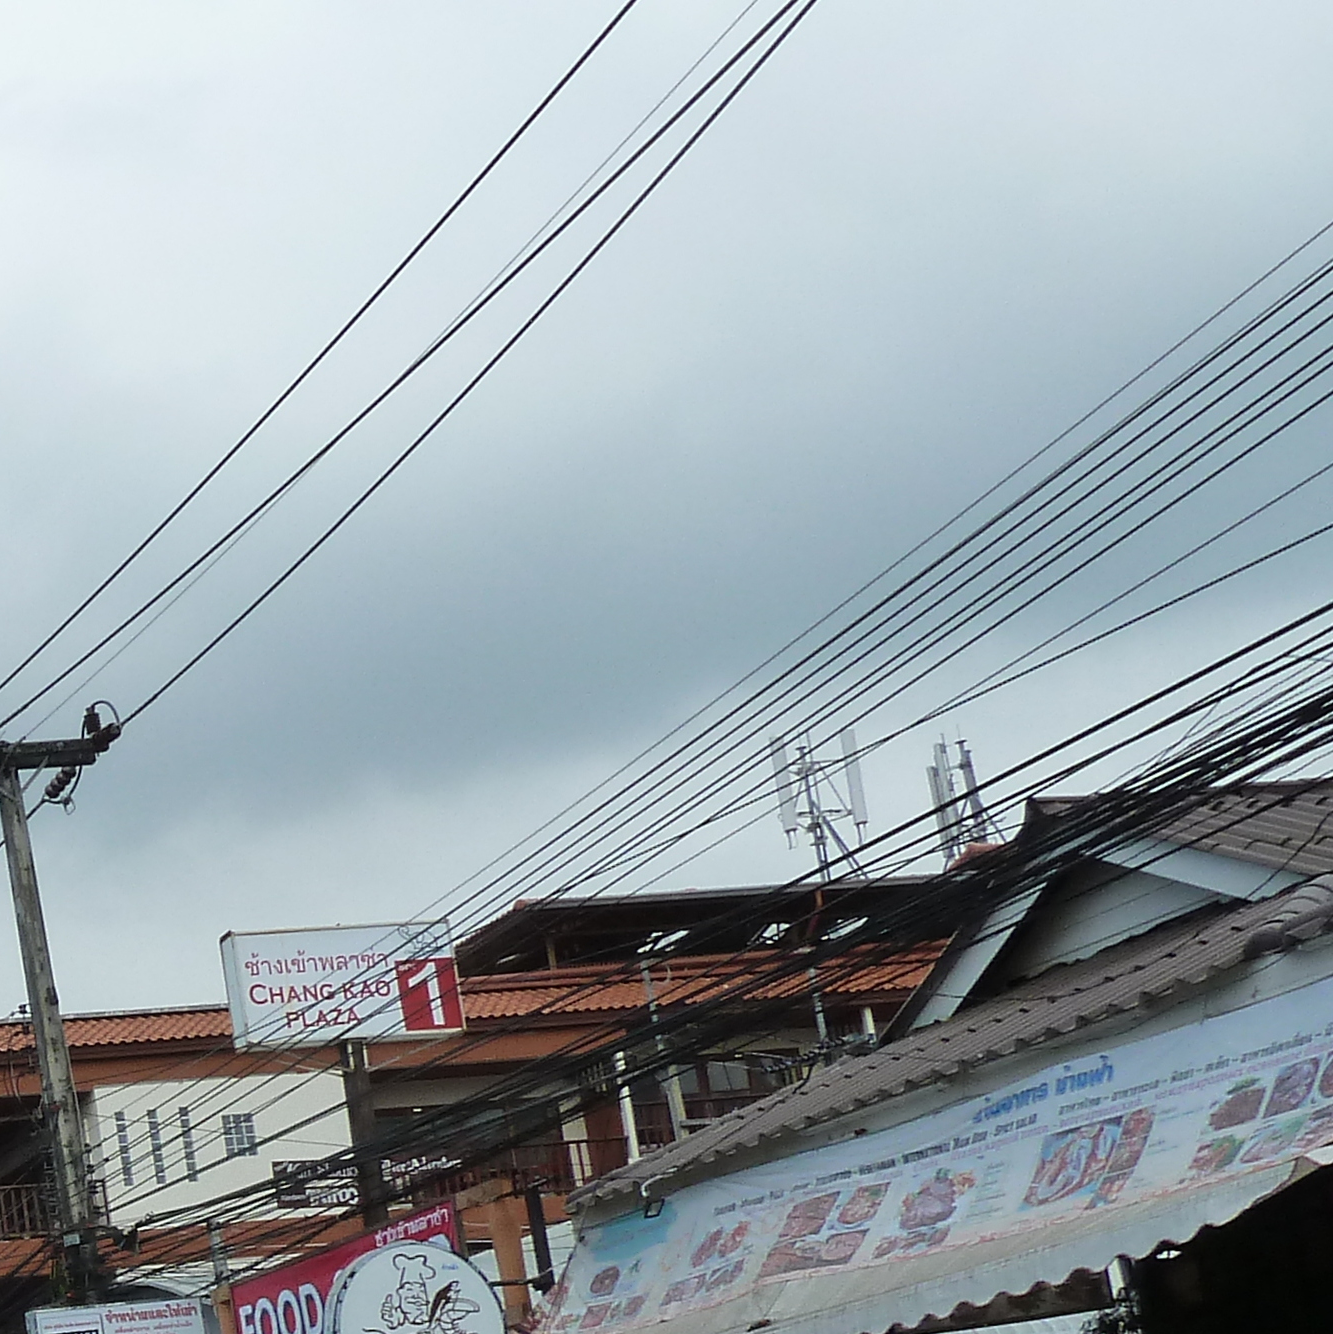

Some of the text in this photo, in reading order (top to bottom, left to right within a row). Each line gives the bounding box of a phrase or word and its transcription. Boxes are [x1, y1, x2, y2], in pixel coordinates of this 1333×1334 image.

[249, 980, 392, 1005] CHANG KAO
[408, 961, 446, 1026] 1
[286, 1008, 362, 1029] PLAZA
